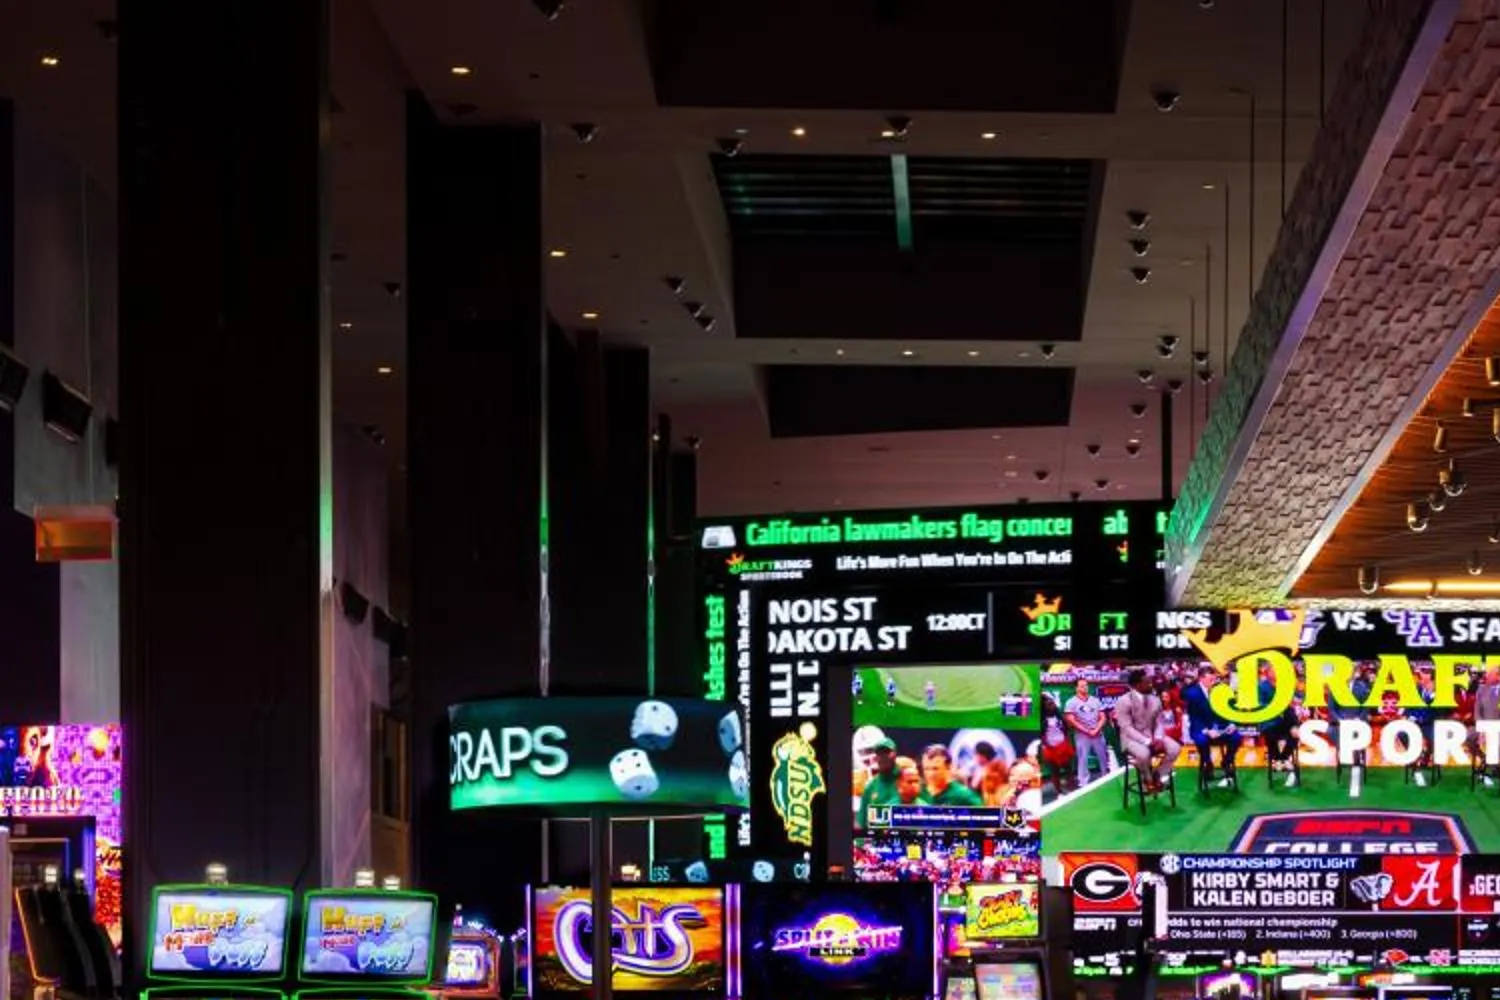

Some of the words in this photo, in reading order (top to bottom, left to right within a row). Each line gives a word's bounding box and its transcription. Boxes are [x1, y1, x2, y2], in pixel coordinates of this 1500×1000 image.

[745, 518, 841, 546] California
[844, 515, 957, 543] lawmakers
[960, 513, 1004, 543] flag
[768, 599, 839, 625] NOIS
[843, 597, 877, 623] ST
[1332, 611, 1375, 631] VS.
[877, 624, 912, 651] ST
[769, 663, 793, 717] ILLI
[1183, 857, 1283, 869] CHAMPIONSHIP
[1285, 857, 1358, 869] SPOTLIGHT
[1193, 872, 1251, 889] KIRBY
[1254, 872, 1322, 889] SMART
[1325, 872, 1340, 888] &
[1193, 890, 1257, 907] KALEN
[1204, 918, 1222, 928] win
[1223, 917, 1265, 928] national
[1266, 917, 1338, 930] championship
[1193, 929, 1217, 939] State
